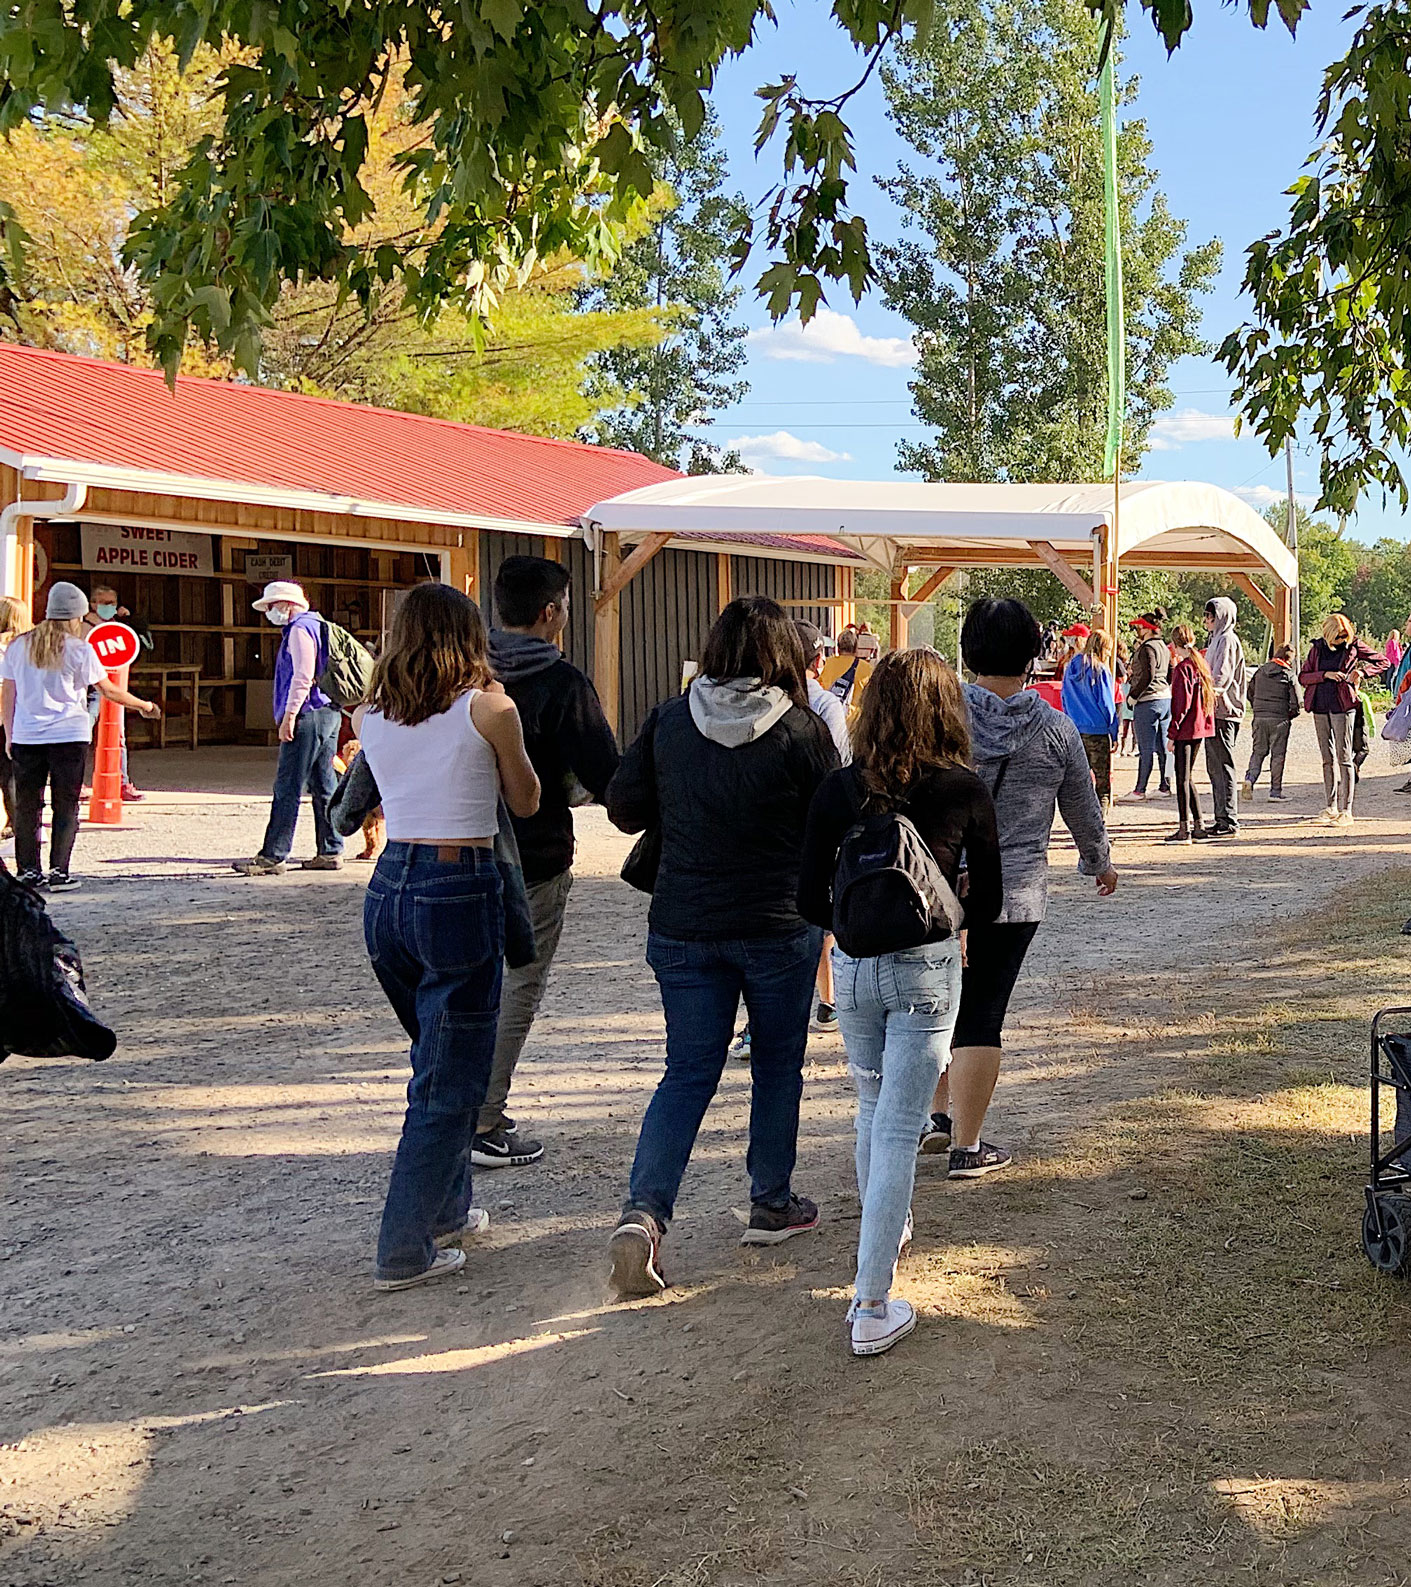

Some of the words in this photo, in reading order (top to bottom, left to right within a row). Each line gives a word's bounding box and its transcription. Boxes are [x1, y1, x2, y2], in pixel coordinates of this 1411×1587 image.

[120, 526, 172, 542] SWEET
[96, 546, 148, 566] APPLE
[152, 550, 199, 569] CIDER
[97, 635, 127, 657] IN
